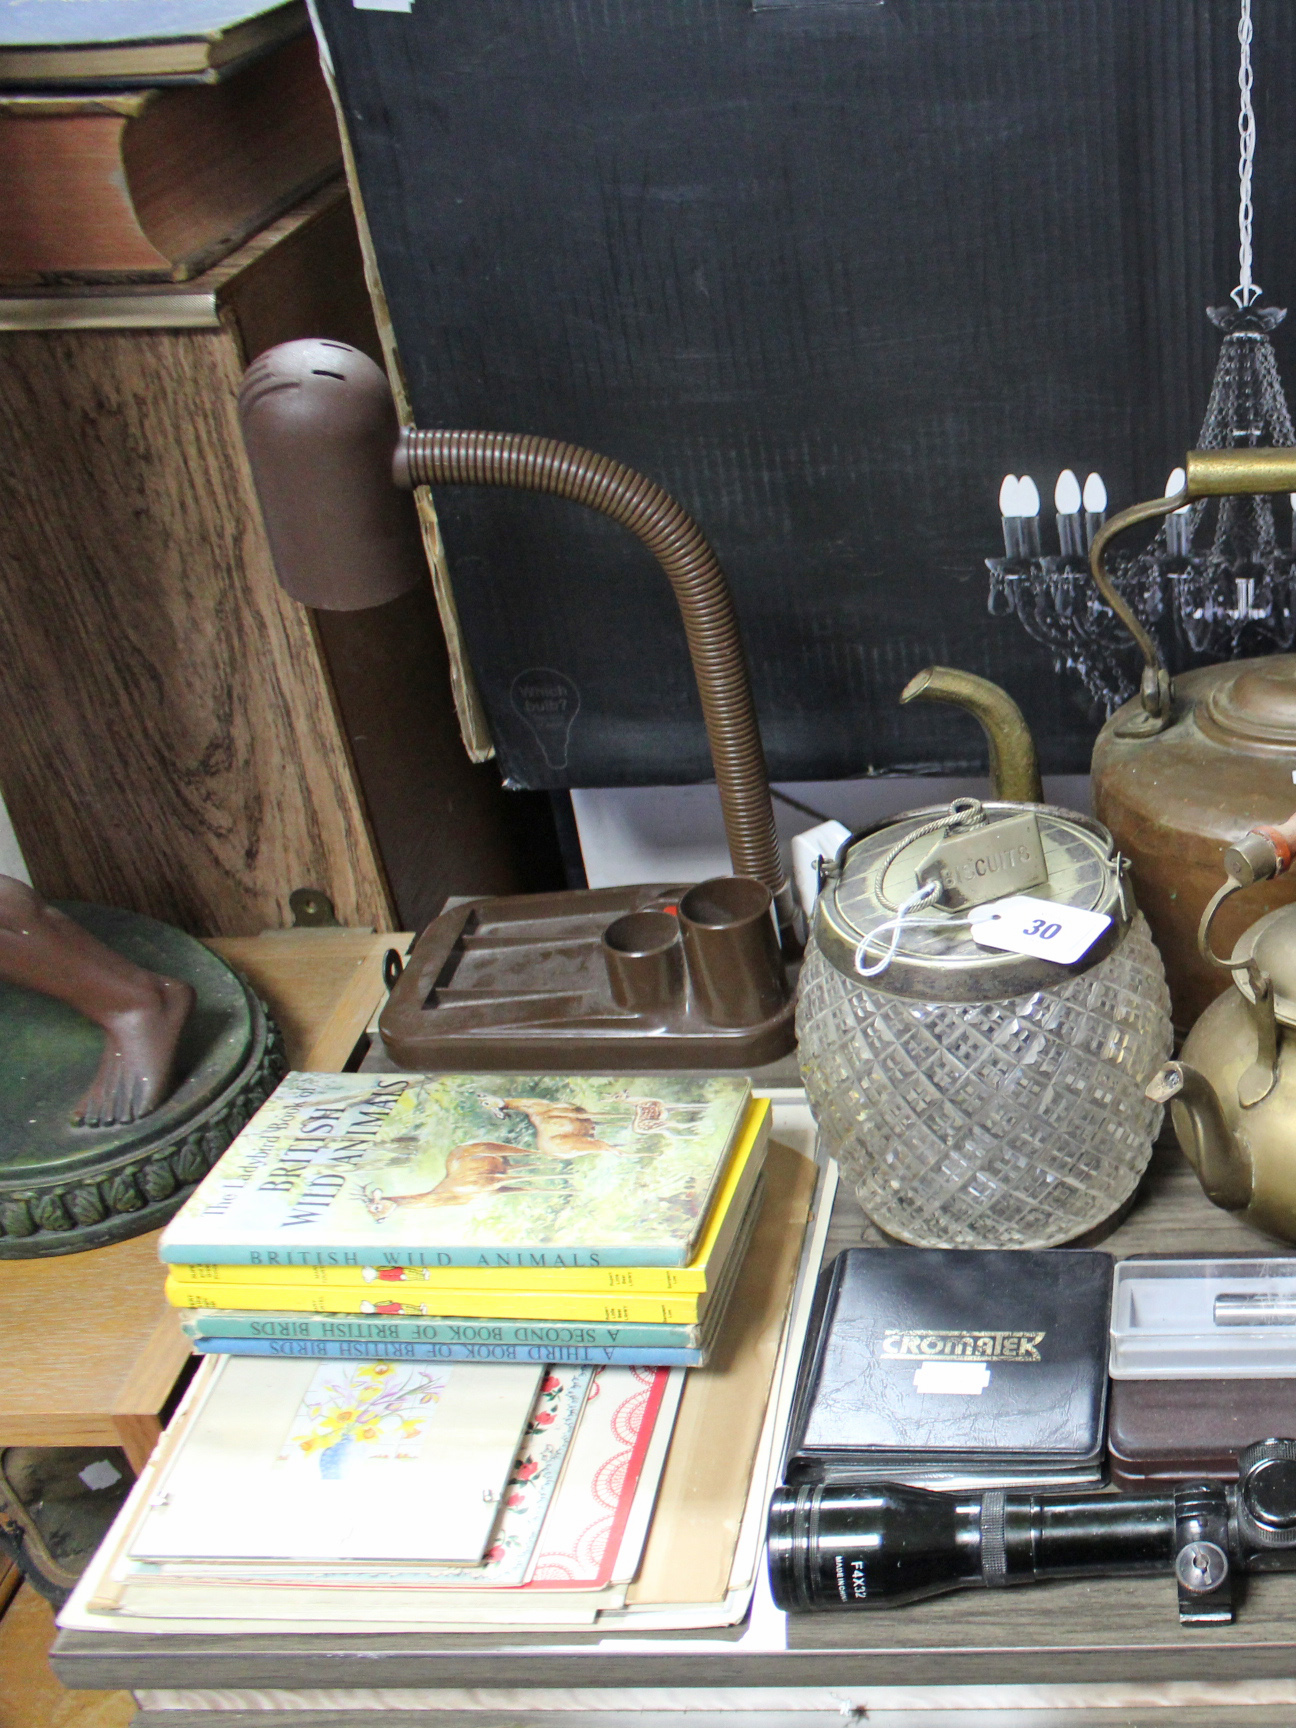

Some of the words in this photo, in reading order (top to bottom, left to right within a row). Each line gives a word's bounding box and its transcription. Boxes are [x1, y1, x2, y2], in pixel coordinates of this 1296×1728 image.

[1022, 918, 1063, 941] 30
[202, 1194, 238, 1217] The
[223, 1134, 282, 1190] Ladybird
[270, 1101, 304, 1133] Book
[300, 1085, 317, 1099] of
[257, 1107, 347, 1193] BRITISH
[279, 1173, 346, 1228] WILD
[328, 1079, 410, 1167] ANIMALS
[250, 1251, 359, 1265] BRITISH
[383, 1252, 453, 1266] WILD
[477, 1253, 601, 1267] ANIMALS
[251, 1321, 310, 1337] BIRDS
[322, 1323, 400, 1339] BRITISH
[411, 1325, 438, 1340] OF
[449, 1326, 503, 1341] BOOK
[514, 1327, 597, 1343] SECOND
[607, 1328, 621, 1342] A
[268, 1341, 328, 1356] BIRDS
[339, 1342, 416, 1358] BRITISH
[429, 1343, 453, 1359] OF
[464, 1345, 517, 1360] BOOK
[528, 1346, 593, 1361] THIRD
[880, 1330, 1047, 1361] CROMATEK
[604, 1348, 616, 1361] A
[834, 1555, 845, 1578] MADE
